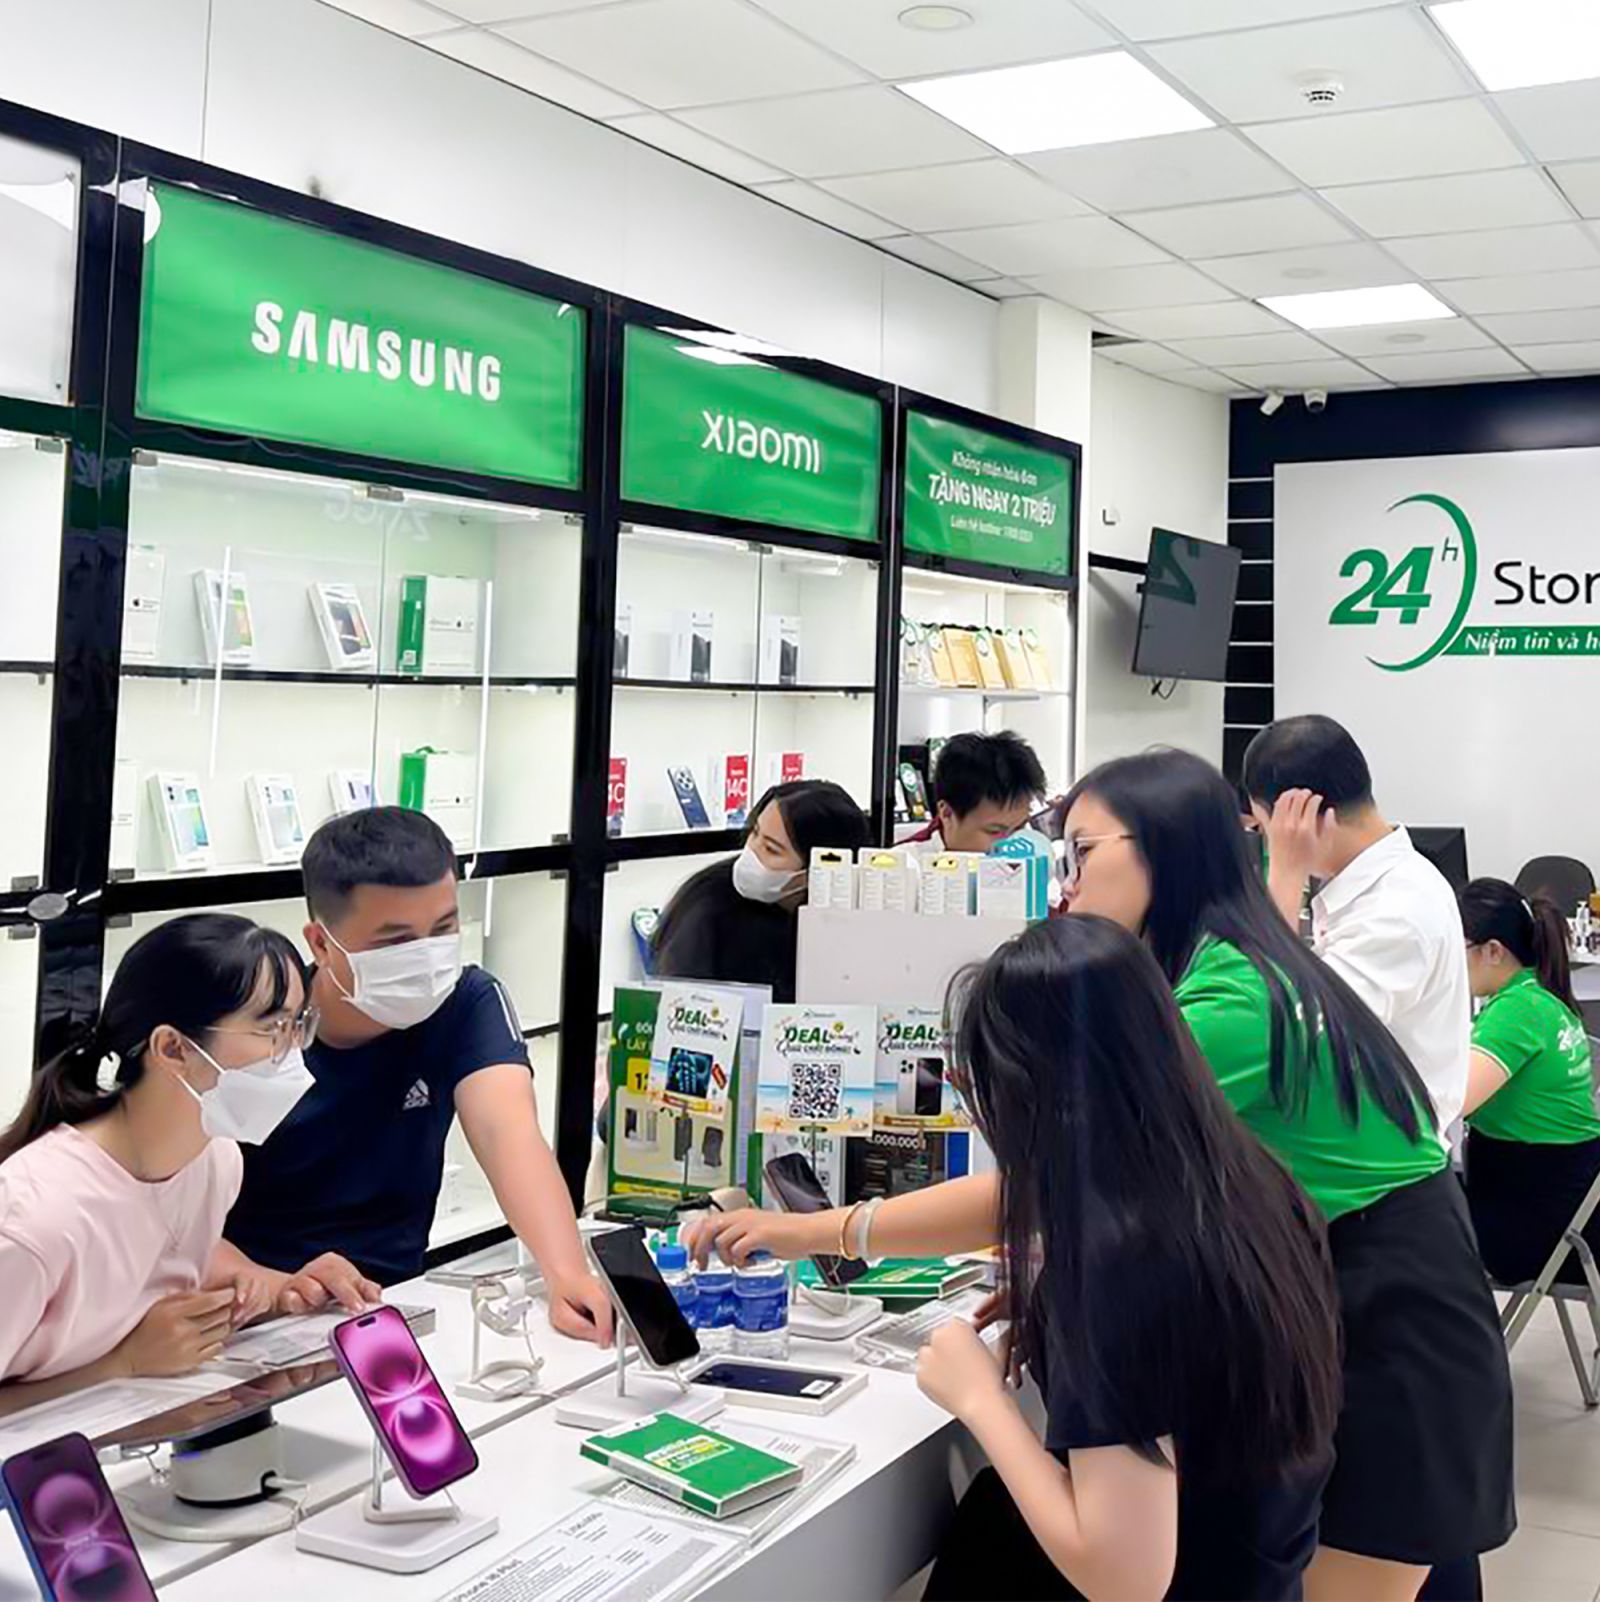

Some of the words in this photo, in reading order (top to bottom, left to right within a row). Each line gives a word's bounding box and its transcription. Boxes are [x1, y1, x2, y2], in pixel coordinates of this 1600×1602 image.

[251, 300, 501, 402] SAMSUNG
[701, 409, 821, 475] xiaomi
[928, 470, 970, 506] TẶNG
[972, 484, 1009, 515] NGAY
[1010, 494, 1021, 518] 2
[1021, 495, 1057, 528] TRIỆU
[1557, 631, 1579, 650] và
[1585, 631, 1600, 650] h
[784, 1025, 831, 1043] DEAL
[886, 1023, 936, 1041] DEAL
